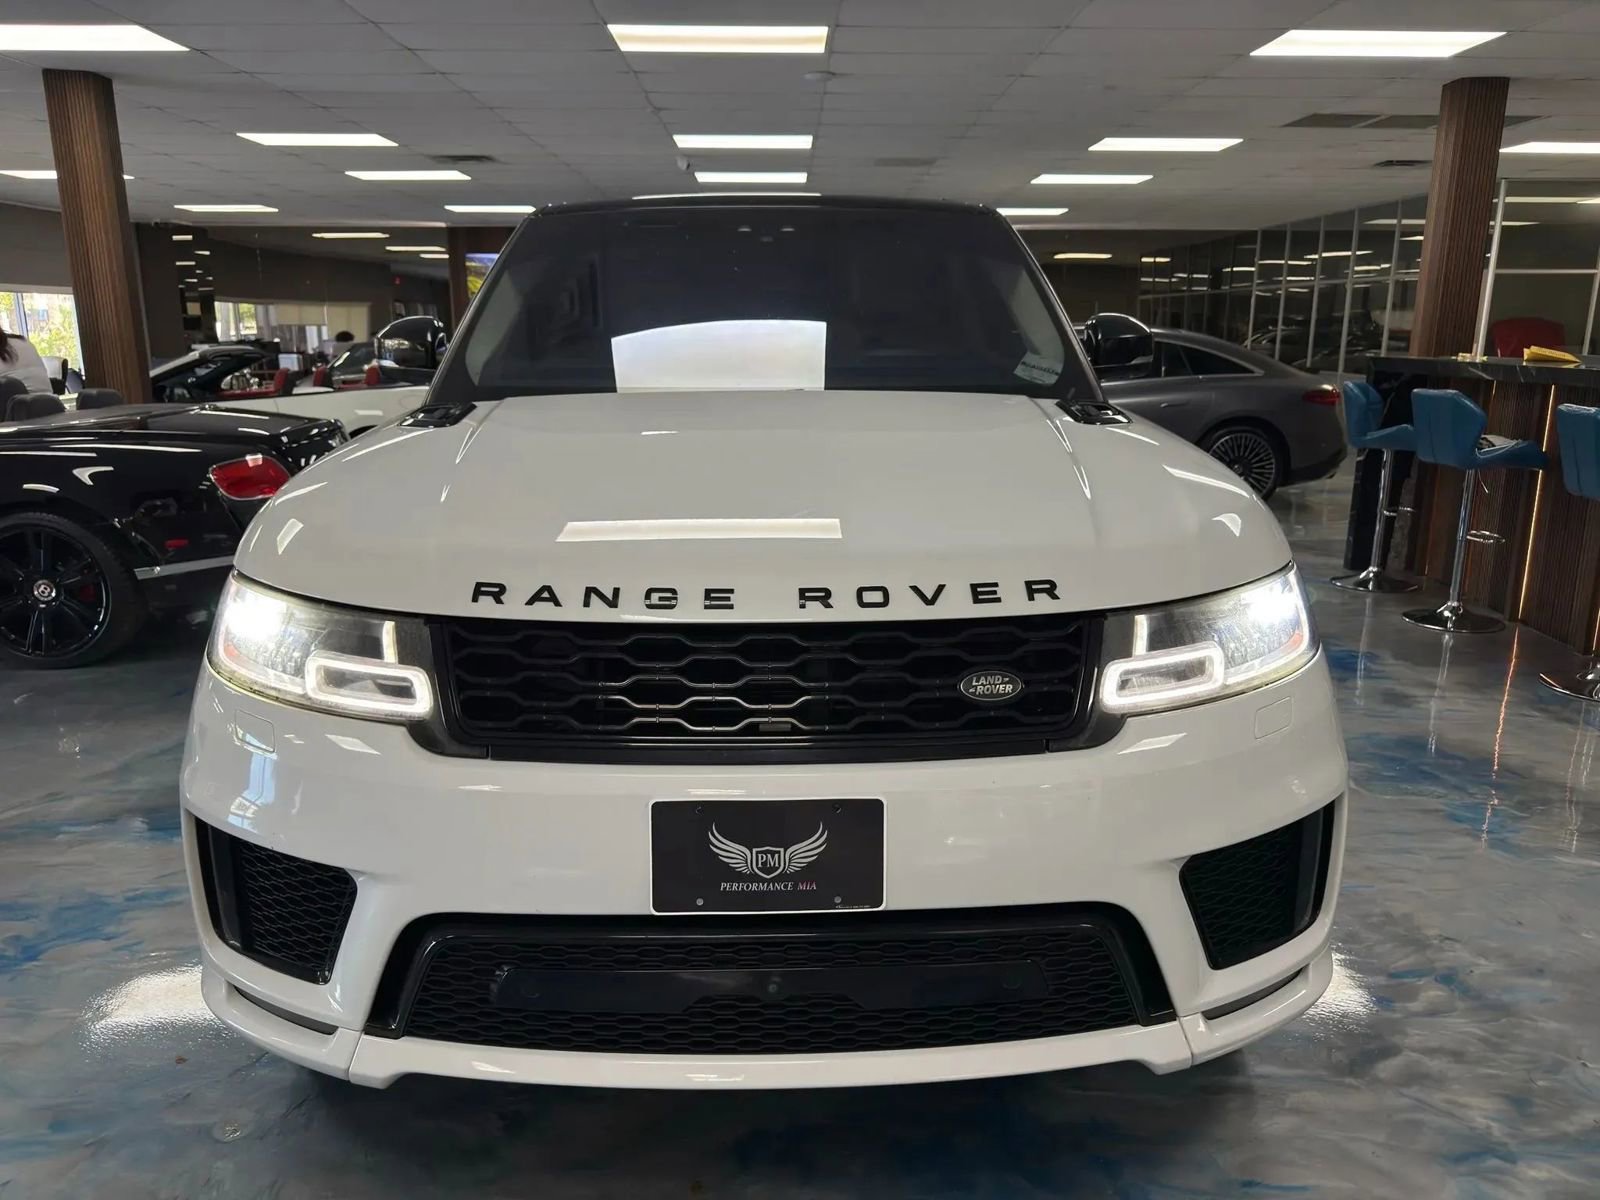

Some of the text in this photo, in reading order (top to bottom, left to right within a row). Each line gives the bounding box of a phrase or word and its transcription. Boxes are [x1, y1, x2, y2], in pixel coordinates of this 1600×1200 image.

[471, 579, 1061, 610] RANGE ROVER
[972, 675, 1002, 685] LAND
[976, 684, 1013, 695] ROVER
[757, 854, 780, 868] PM
[720, 881, 817, 892] PERFORMANCE MIA
